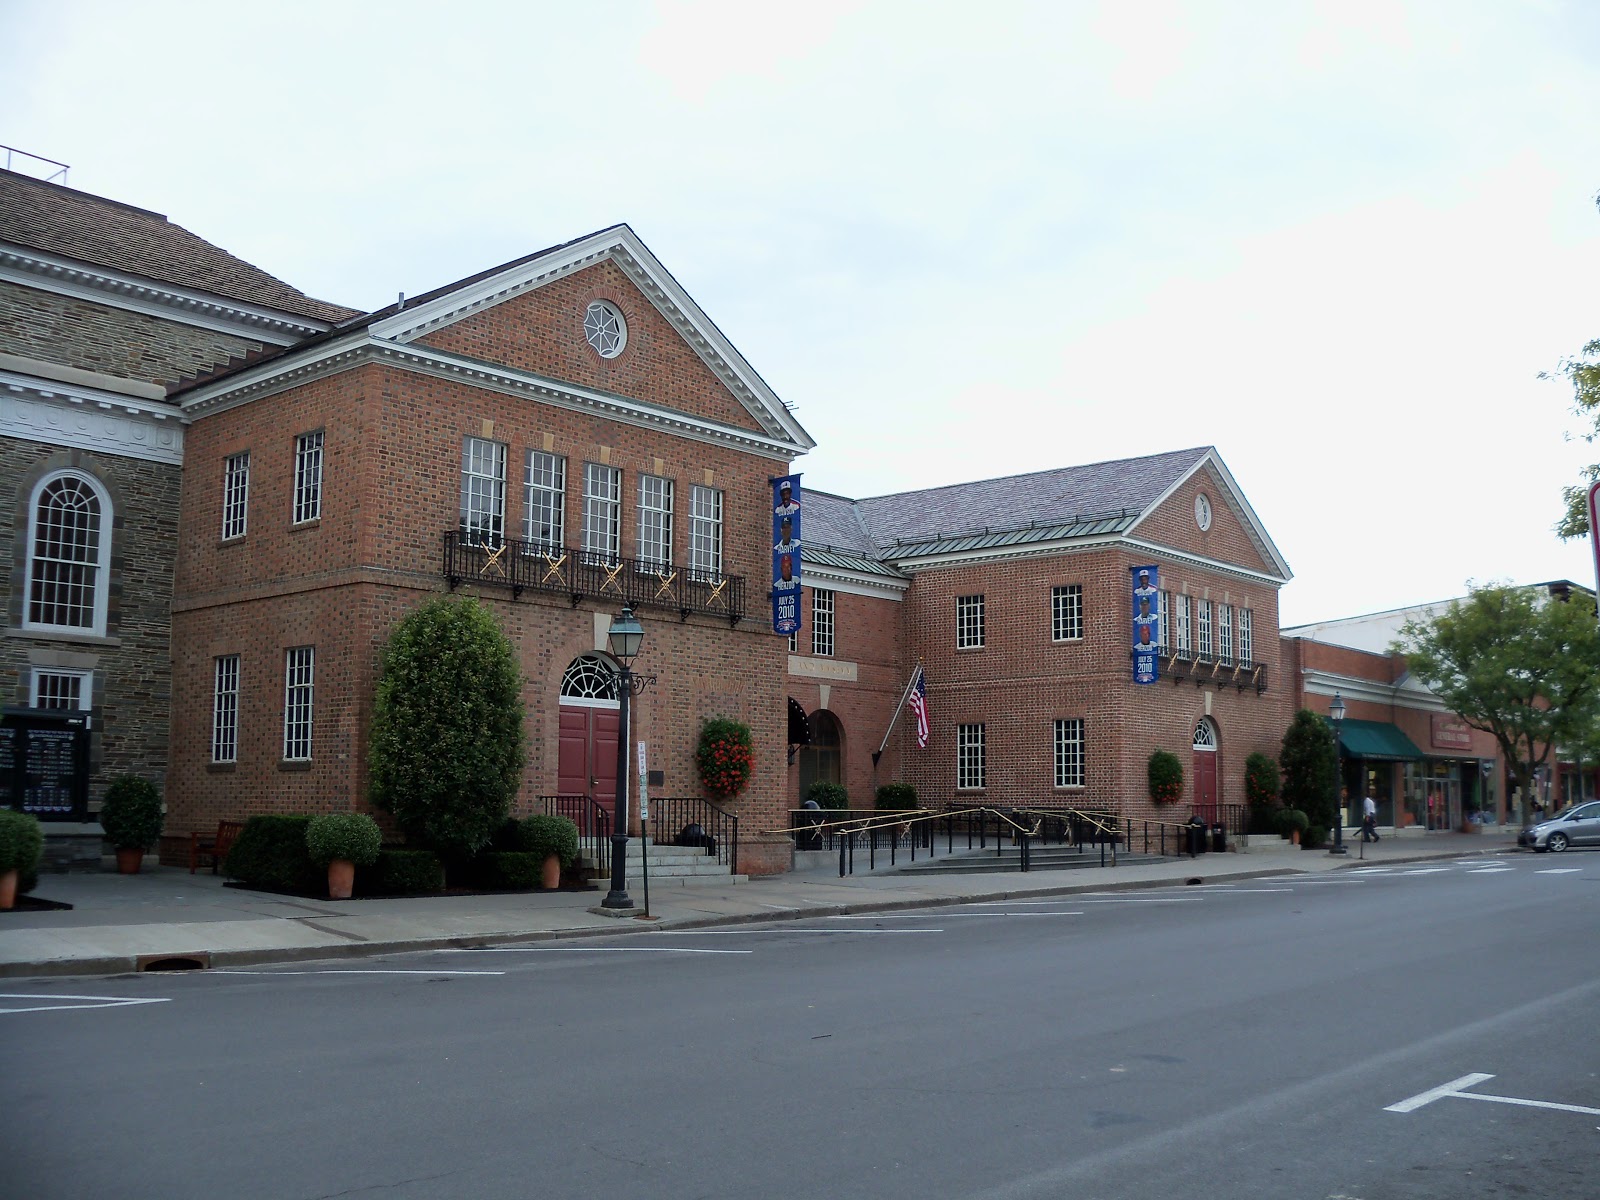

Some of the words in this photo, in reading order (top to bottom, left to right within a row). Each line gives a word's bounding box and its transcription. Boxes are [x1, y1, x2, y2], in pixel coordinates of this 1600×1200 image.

[777, 545, 795, 555] HARVEY
[778, 596, 788, 606] JULY
[788, 594, 795, 605] 25
[778, 605, 795, 619] 2010
[1147, 655, 1153, 663] 25
[1138, 663, 1153, 673] 2010
